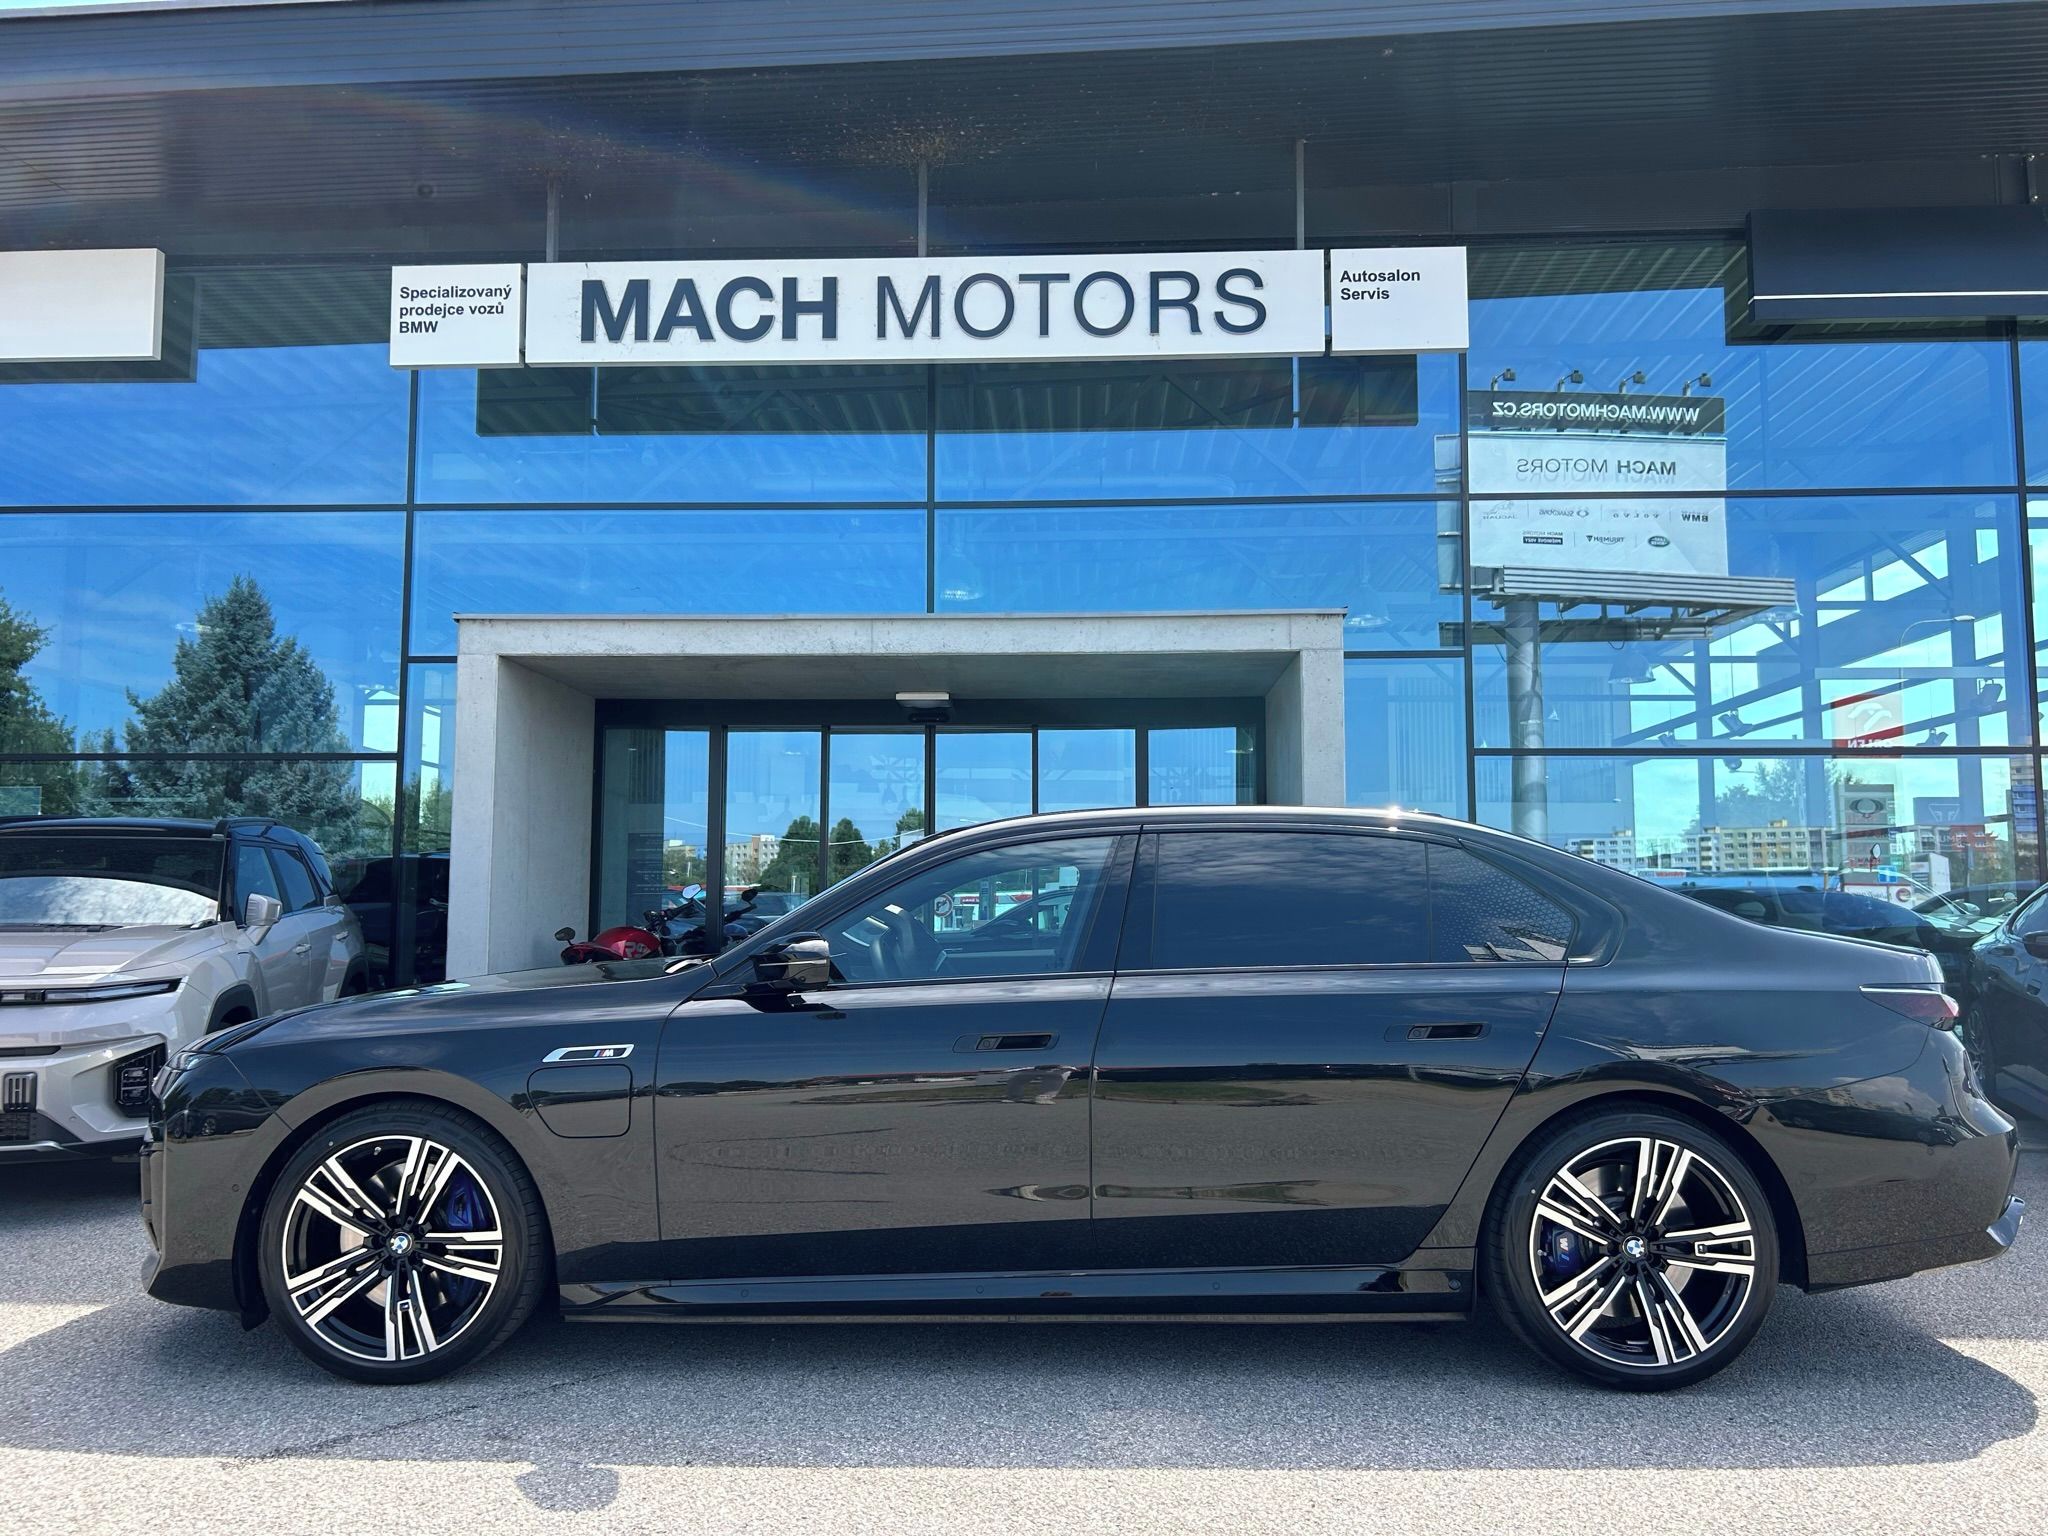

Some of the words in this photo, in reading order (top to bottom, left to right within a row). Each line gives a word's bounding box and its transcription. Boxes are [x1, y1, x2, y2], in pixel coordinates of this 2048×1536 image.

[1340, 269, 1421, 282] Autosalon
[400, 284, 512, 301] Specializovaný
[1340, 287, 1390, 300] Servis
[400, 303, 464, 319] prodejce
[469, 301, 504, 315] vozů
[580, 276, 839, 344] MACH
[876, 268, 1268, 340] MOTORS
[399, 321, 439, 333] BMW
